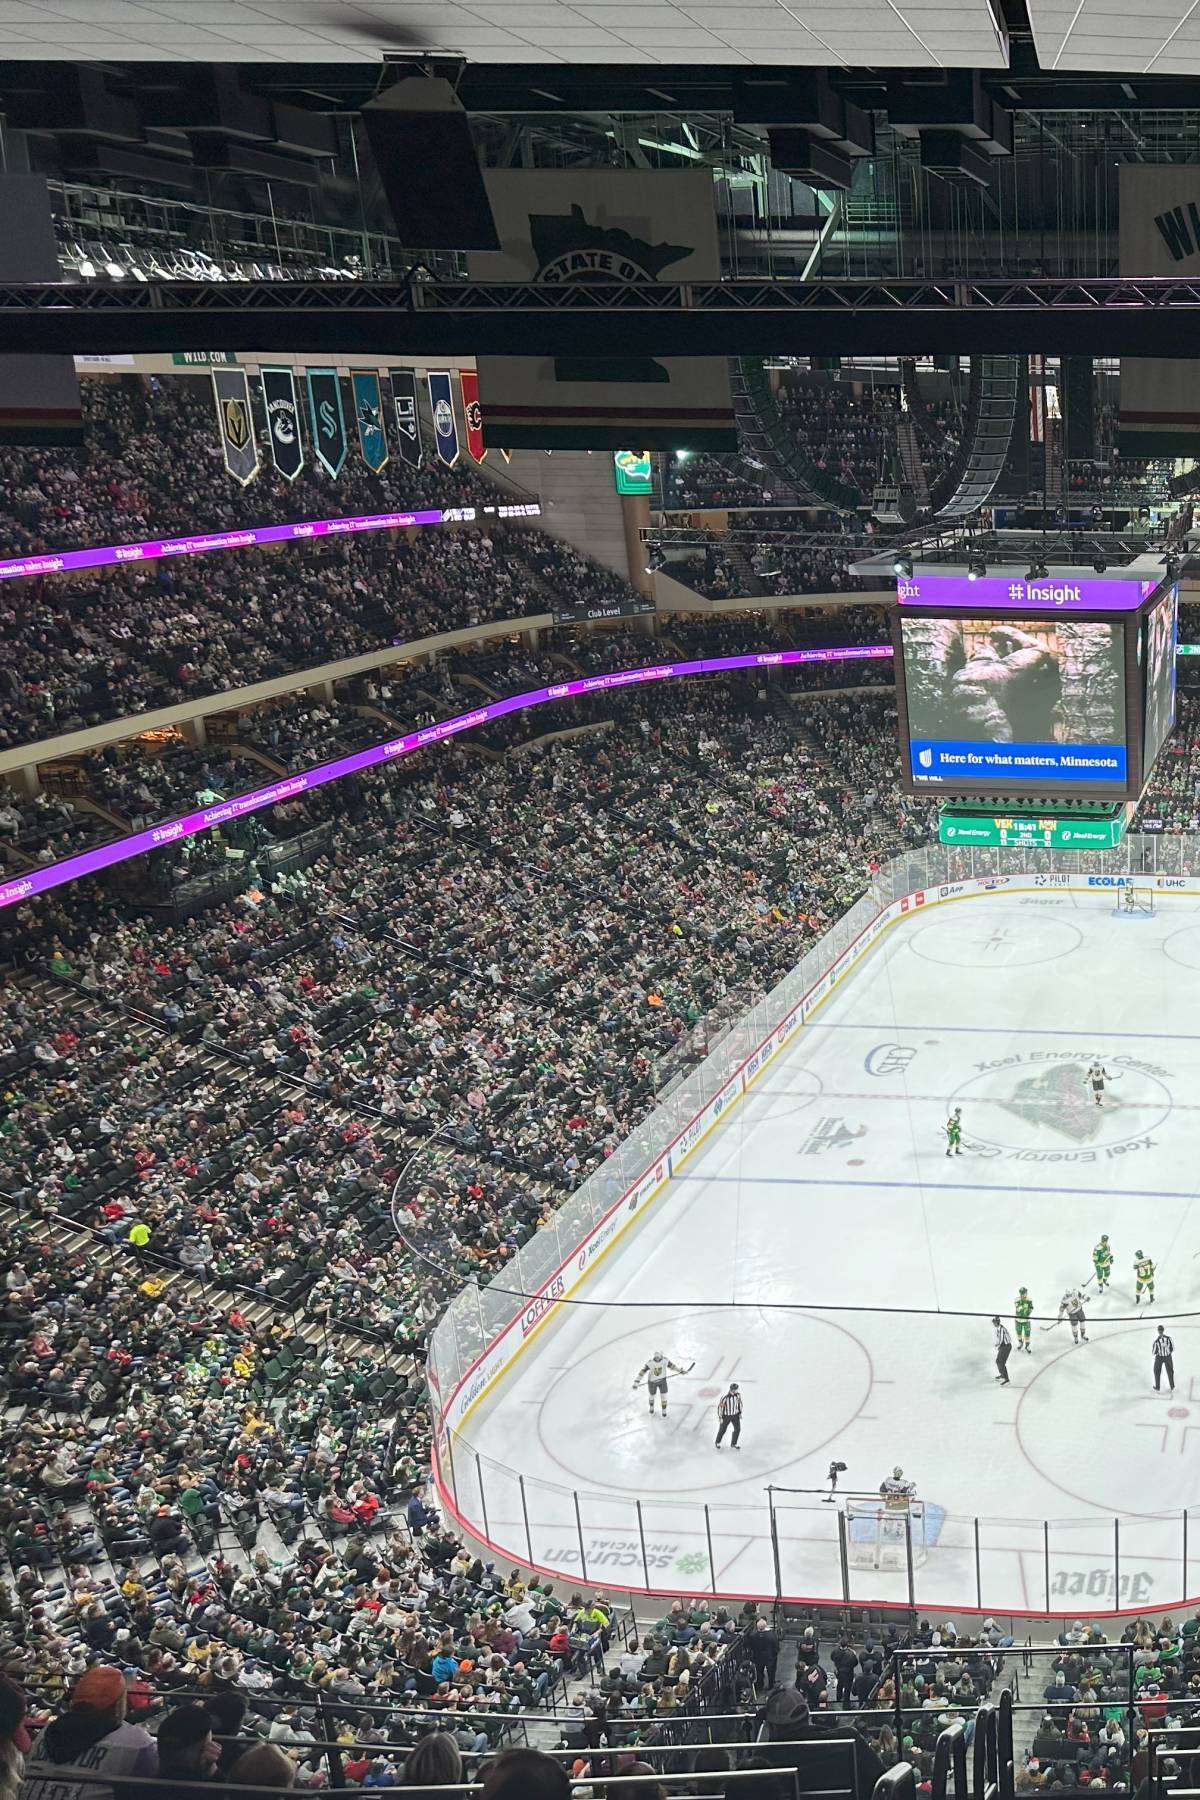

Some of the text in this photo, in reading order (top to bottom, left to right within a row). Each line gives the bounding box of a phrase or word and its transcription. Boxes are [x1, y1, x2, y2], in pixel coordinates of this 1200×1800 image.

[543, 253, 613, 282] STATE
[588, 607, 620, 618] Club Level
[940, 753, 1117, 767] Here for what matters, Minnesota
[972, 1051, 1176, 1079] Xcel Energy Center
[1006, 1136, 1159, 1162] Xcel Energy
[521, 1275, 564, 1332] LOFFLER
